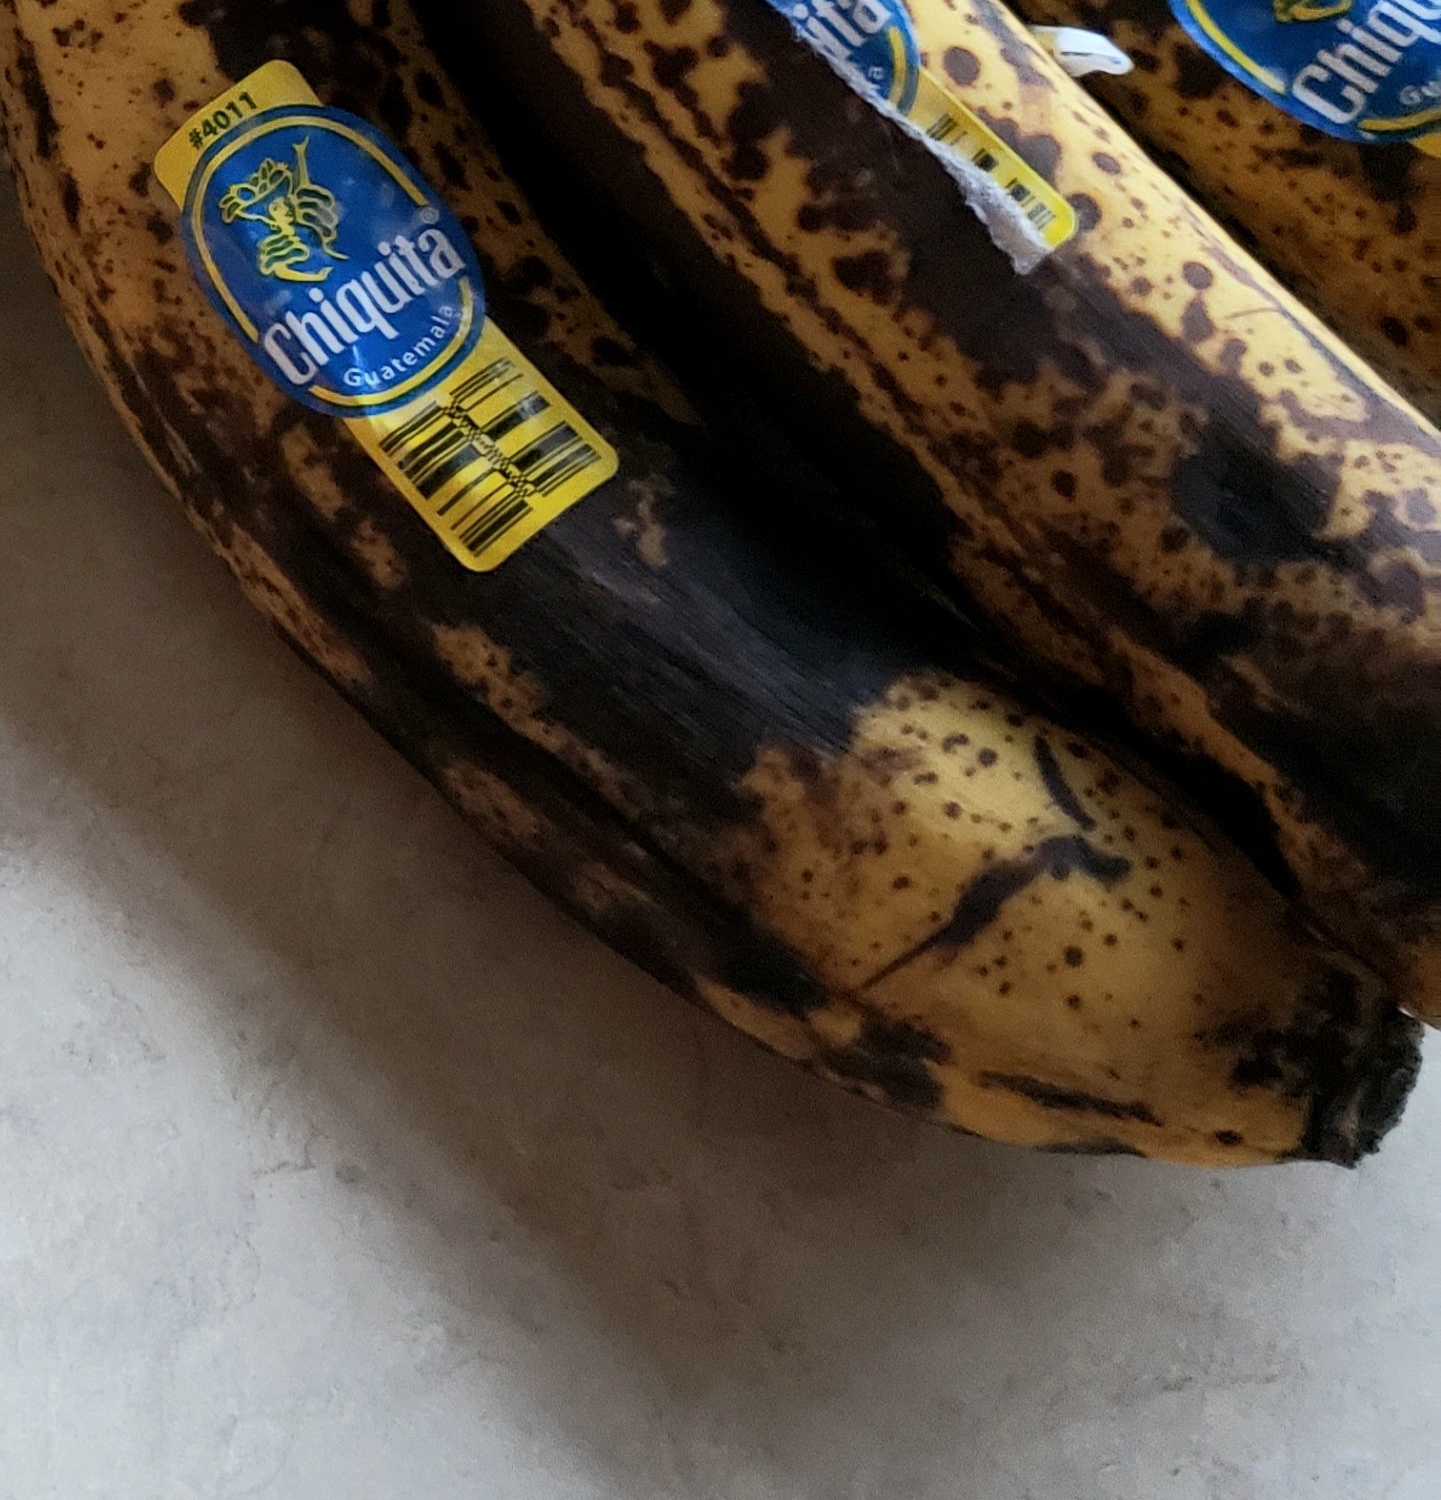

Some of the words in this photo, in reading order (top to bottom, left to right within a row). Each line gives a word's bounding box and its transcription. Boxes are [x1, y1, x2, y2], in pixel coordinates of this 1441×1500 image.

[188, 91, 258, 150] #4011
[263, 228, 465, 385] Chiquita
[343, 303, 454, 387] Guatemala
